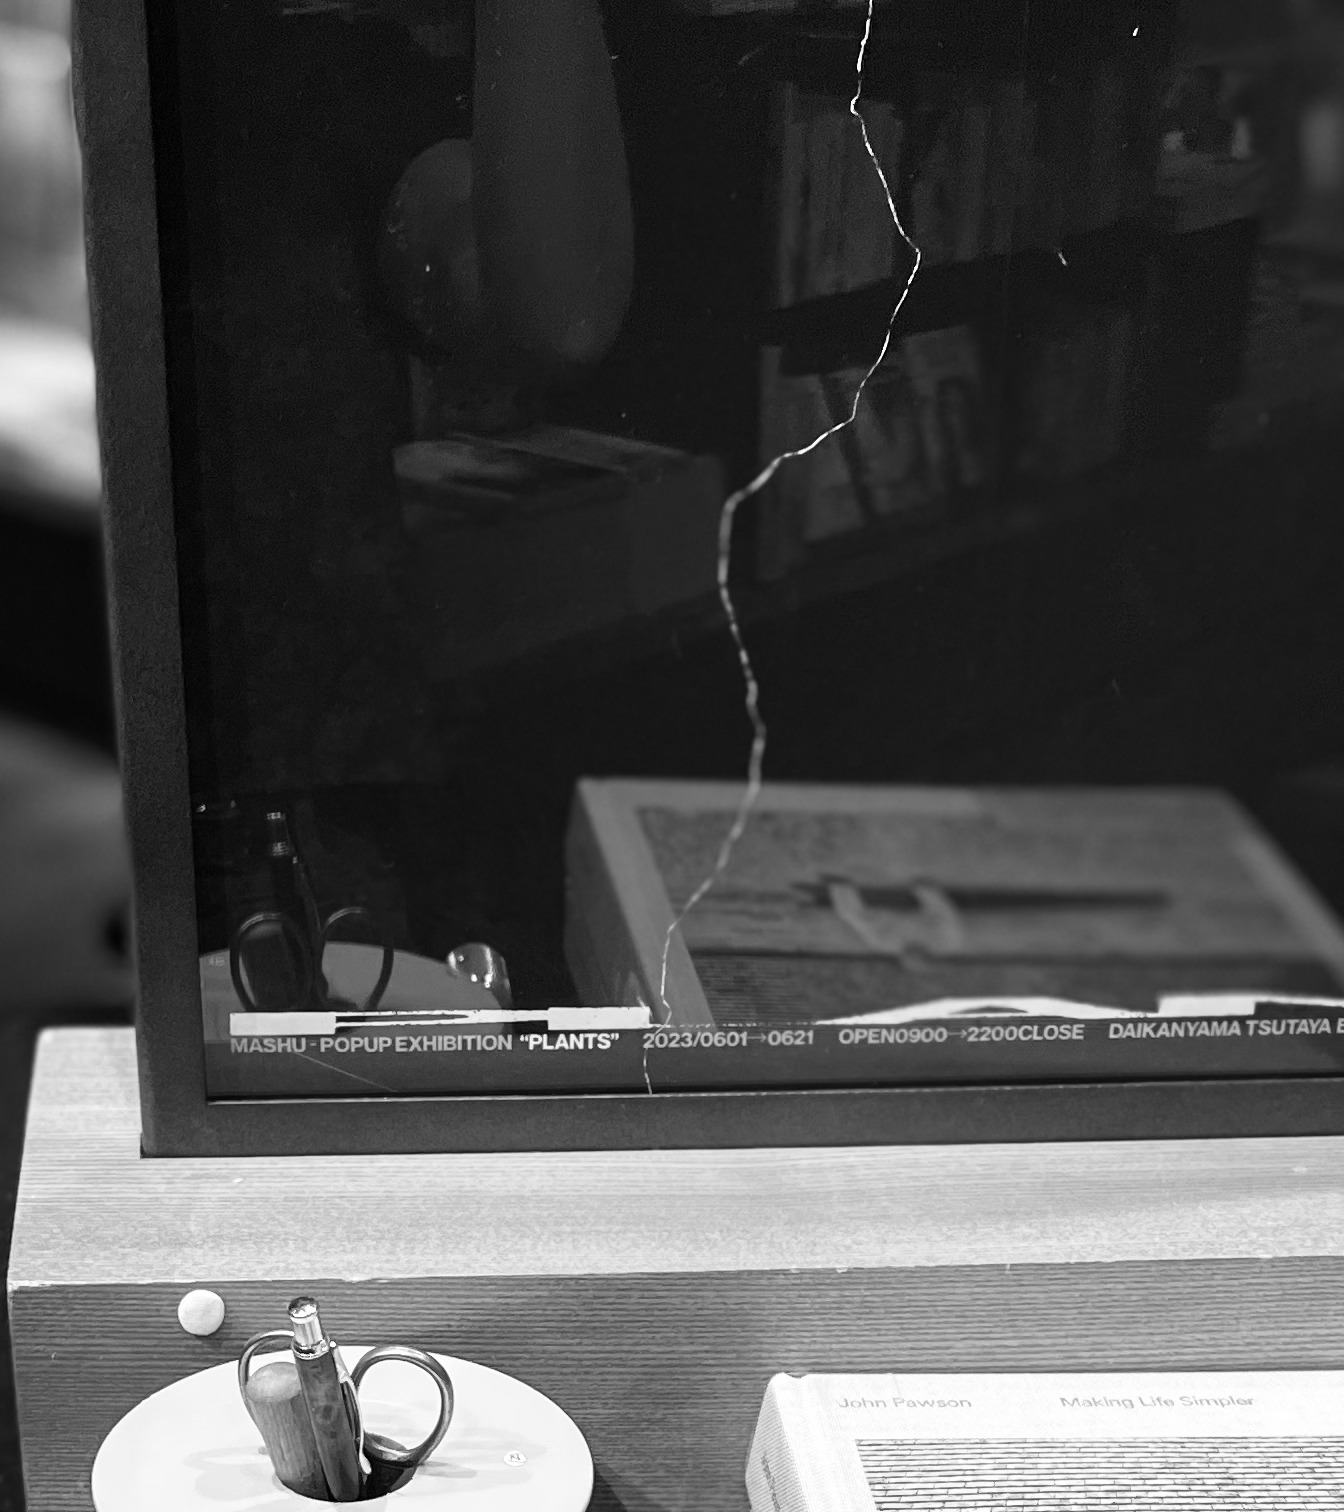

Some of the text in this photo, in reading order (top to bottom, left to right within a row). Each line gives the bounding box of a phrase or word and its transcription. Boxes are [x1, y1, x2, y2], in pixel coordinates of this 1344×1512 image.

[230, 1037, 307, 1053] MASHU
[320, 1036, 392, 1053] POPUP
[394, 1034, 513, 1052] EXHIBITION
[1109, 1020, 1242, 1039] DAIKANYAMA
[1245, 1018, 1332, 1036] TSUTAYA
[838, 1397, 973, 1409] John Pawson
[1059, 1395, 1254, 1410] Making Life Simpler
